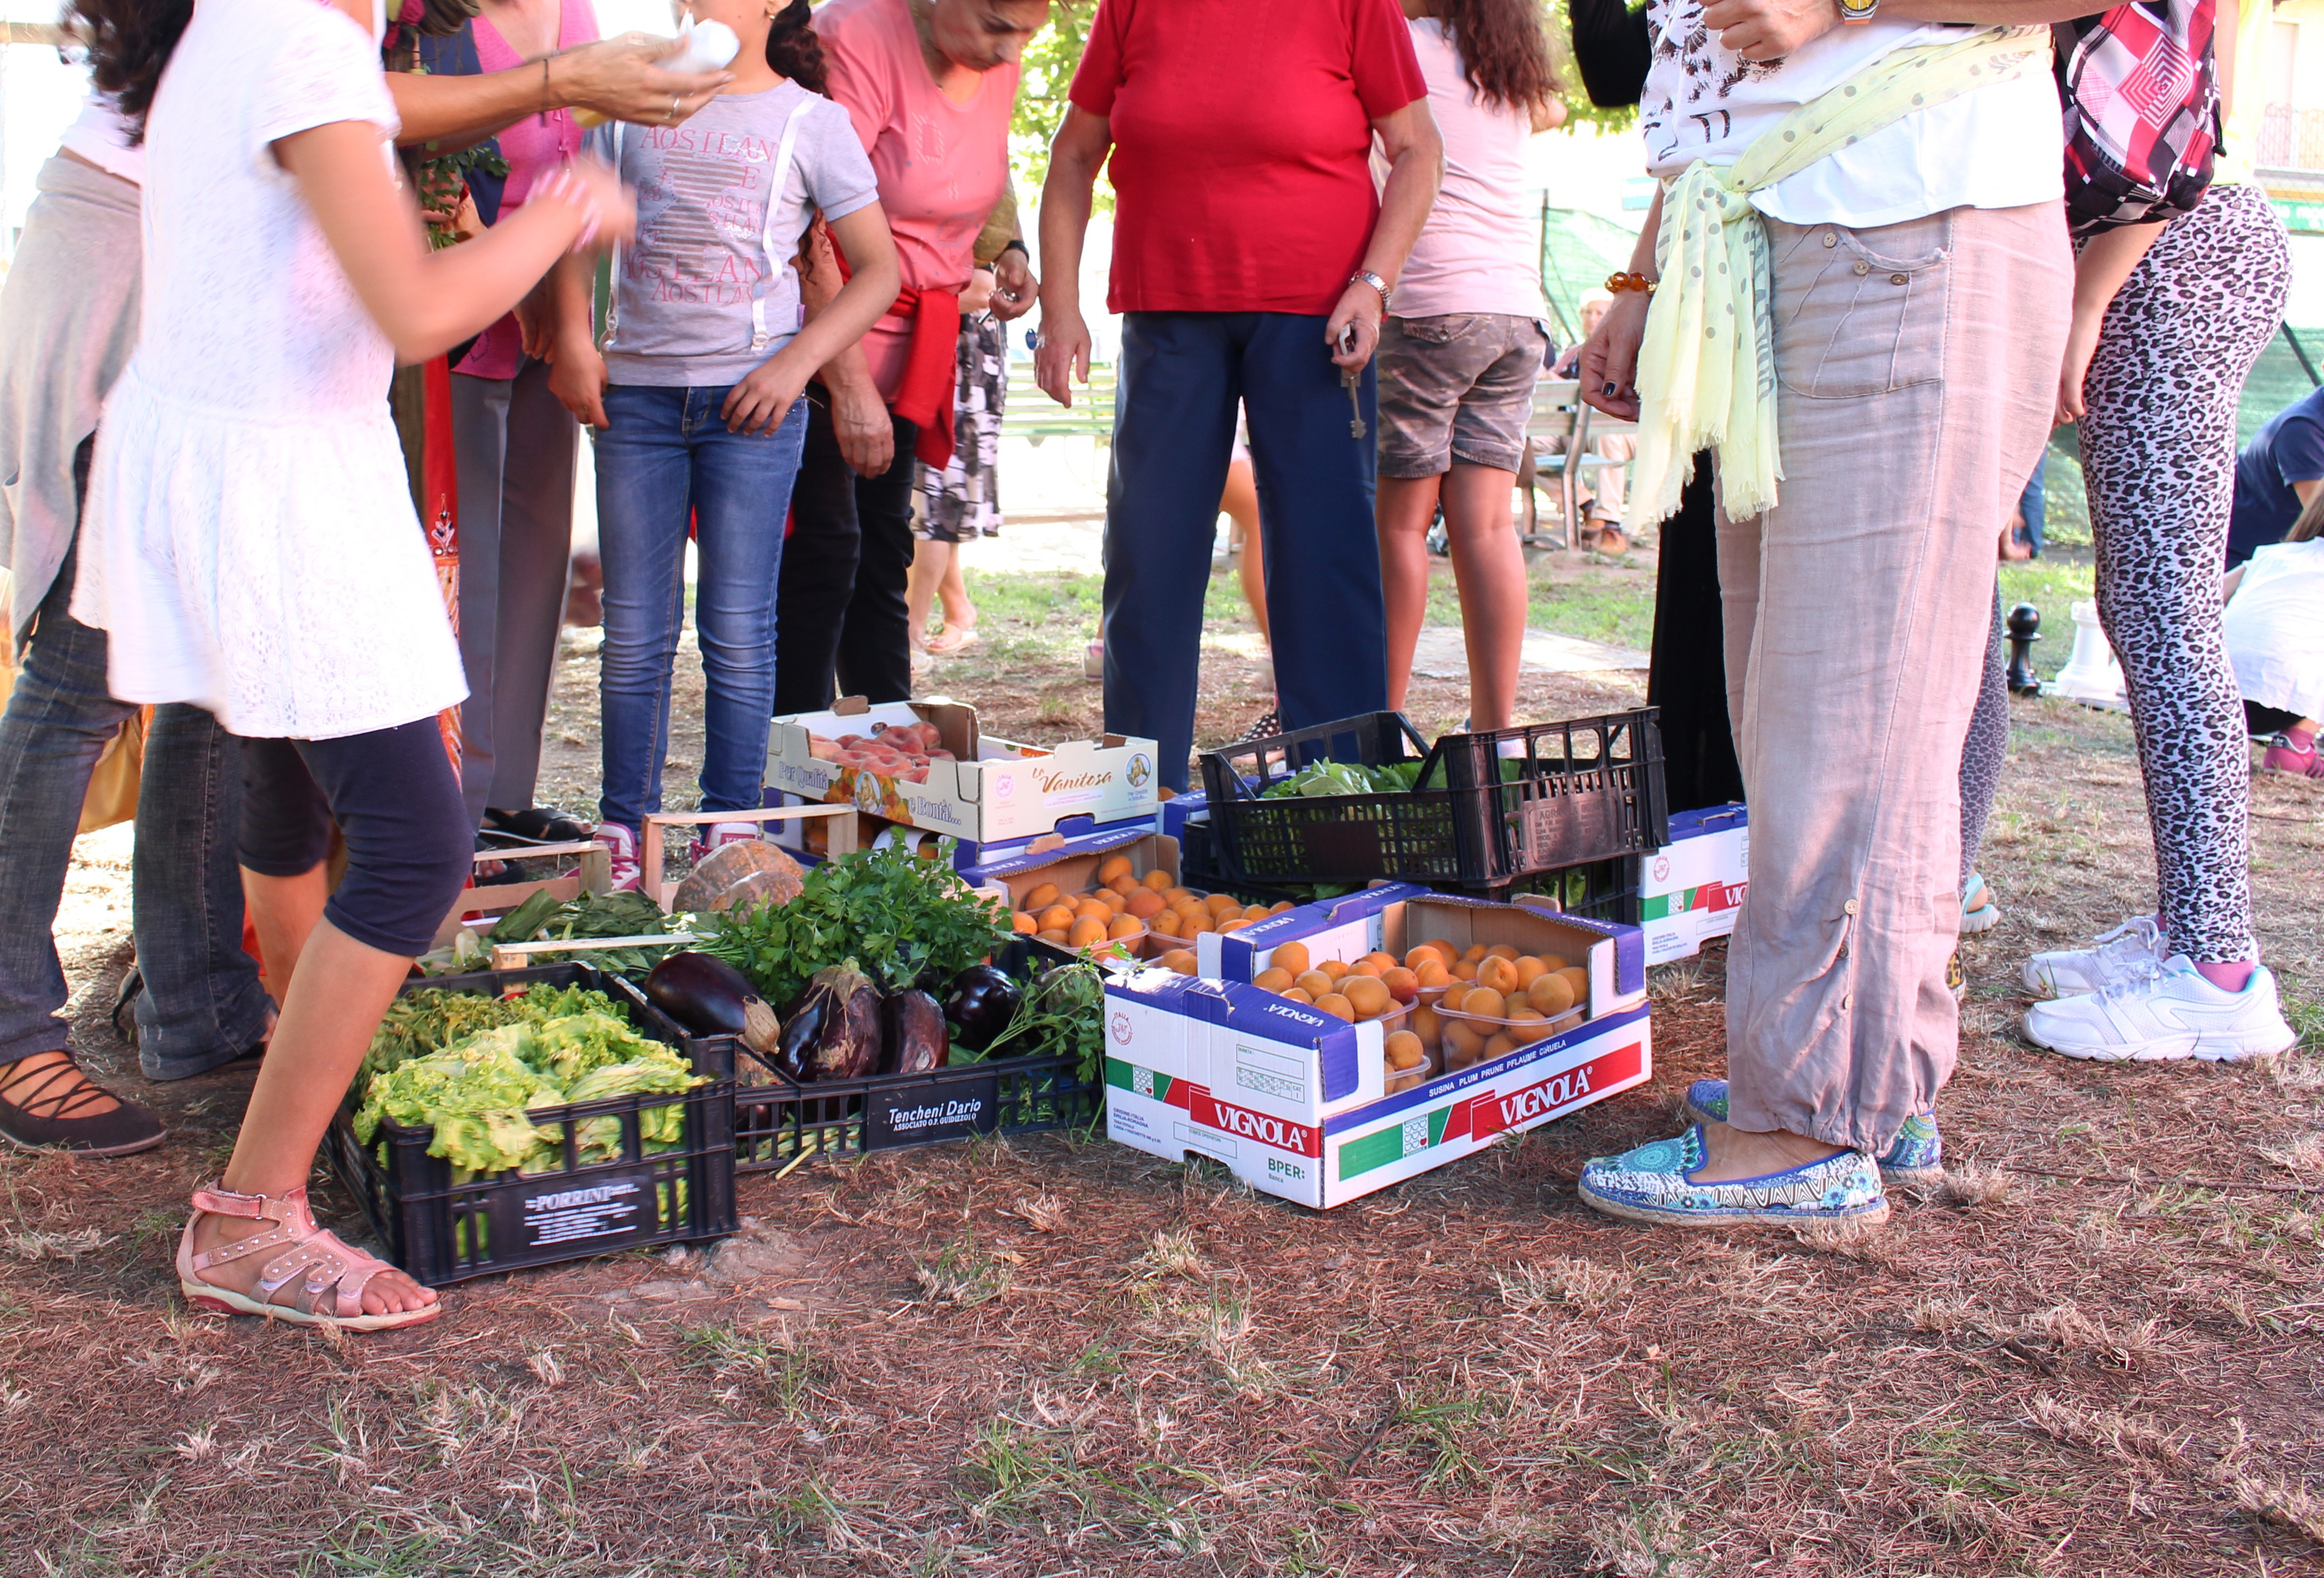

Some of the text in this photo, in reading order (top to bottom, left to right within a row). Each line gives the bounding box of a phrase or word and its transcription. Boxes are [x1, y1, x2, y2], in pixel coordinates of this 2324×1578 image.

[779, 761, 830, 790] Per Qualità
[1038, 770, 1113, 794] Vanitosa
[908, 798, 915, 813] e
[1429, 1081, 1455, 1097] SUSINA
[1459, 1073, 1479, 1087] PLUM
[1481, 1063, 1504, 1079] PRUNE
[1506, 1050, 1537, 1069] PFLAUME
[889, 1098, 981, 1124] Tencheni Dario
[893, 1119, 927, 1131] ASSOCIATO
[1268, 1173, 1284, 1183] Banca
[535, 1185, 612, 1211] PORRINI
